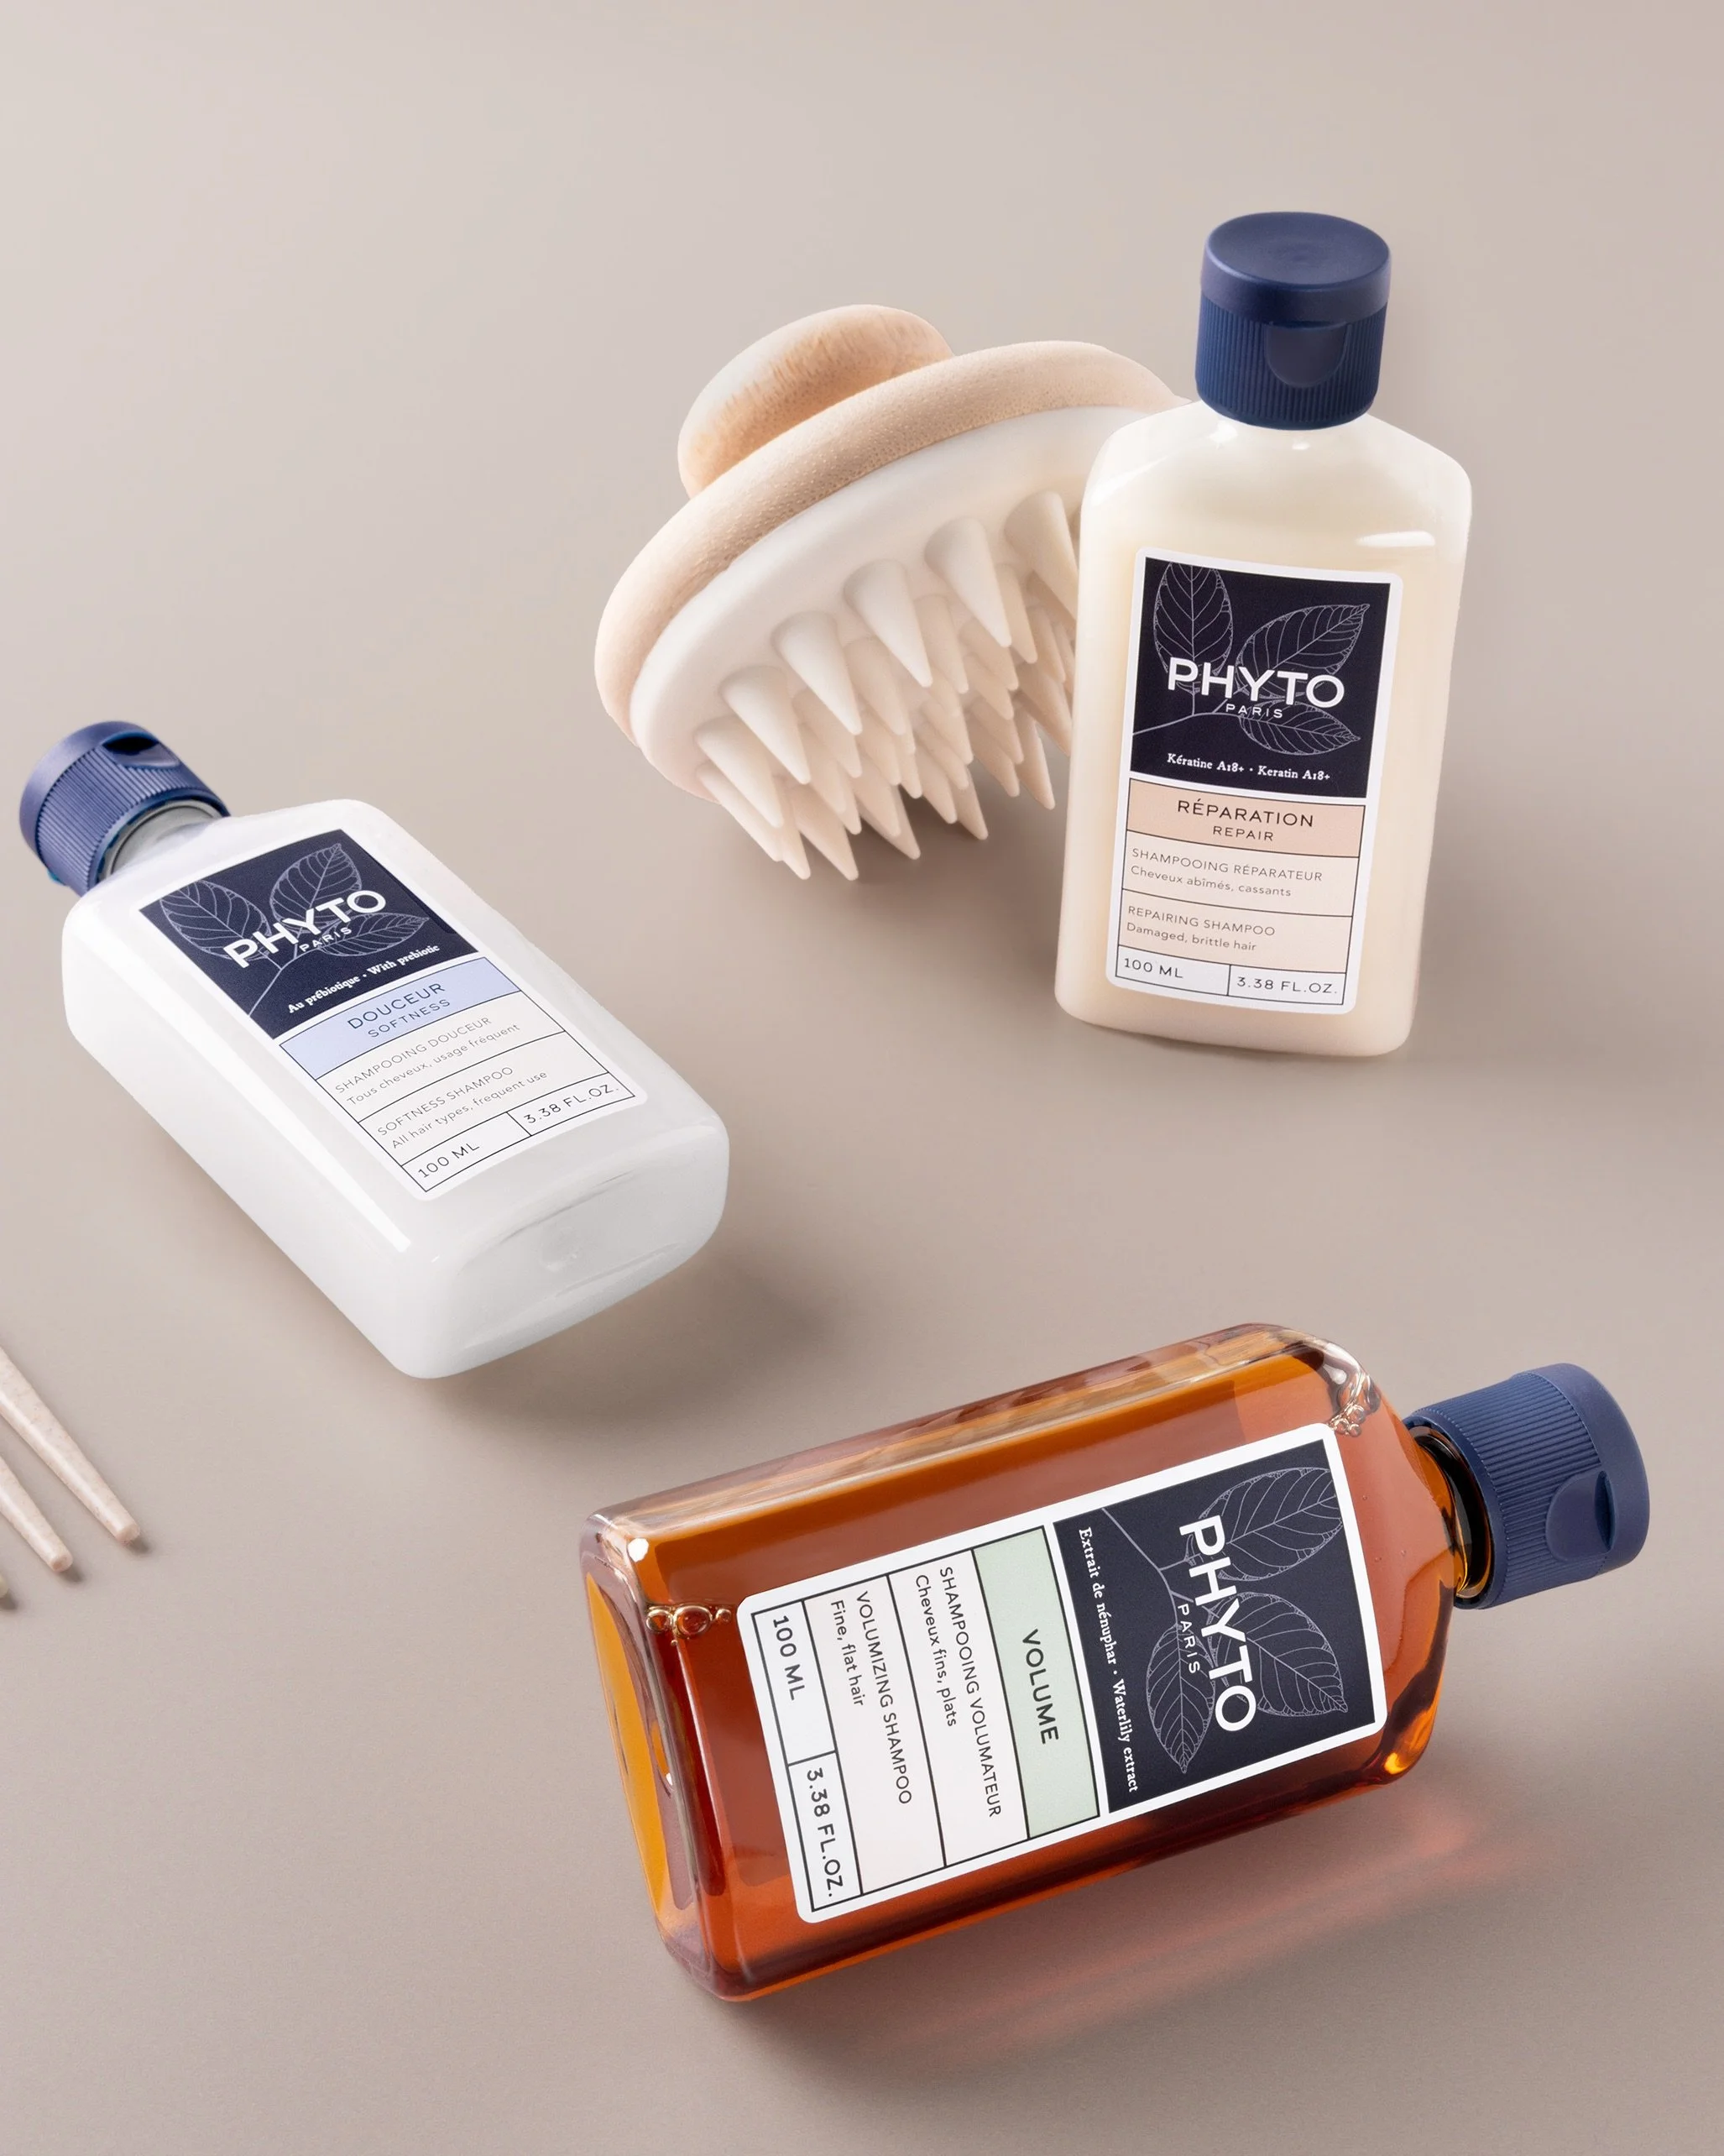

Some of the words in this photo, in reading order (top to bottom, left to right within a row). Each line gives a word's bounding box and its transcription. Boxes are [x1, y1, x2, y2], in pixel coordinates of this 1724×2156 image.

[1168, 657, 1345, 708] PHYTO
[1225, 704, 1283, 719] PARIS
[1167, 753, 1213, 769] Kératine
[1217, 761, 1244, 772] A18+
[1257, 766, 1298, 779] Keratin
[1303, 770, 1330, 781] A18+
[1178, 798, 1314, 827] RÉPARATION
[1213, 826, 1274, 841] REPAIR
[1131, 866, 1183, 883] Cheveux
[1238, 885, 1291, 897] cassants
[1132, 848, 1229, 873] SHAMPOOING
[1234, 864, 1322, 882] RÉPARATEUR
[223, 890, 386, 969] PHYTO
[299, 926, 352, 952] PARIS
[1126, 923, 1188, 944] Damaged,
[1192, 934, 1230, 949] brittle
[1234, 940, 1256, 951] hair
[1128, 906, 1199, 927] REPAIRING
[1204, 919, 1275, 936] SHAMPOO
[288, 1001, 306, 1013] Au
[305, 975, 360, 1007] prébiotique
[367, 960, 397, 976] With
[396, 944, 440, 966] prebiotic
[1124, 958, 1153, 973] 100
[1159, 965, 1183, 978] ML
[1237, 976, 1274, 990] 3.38
[1281, 981, 1337, 994] FL.OZ.
[347, 983, 446, 1030] DOUCEUR
[368, 999, 451, 1039] SOFTNESS
[335, 1044, 427, 1094] SHAMPOOING
[427, 1017, 492, 1049] DOUCEUR
[347, 1086, 378, 1106] Tous
[379, 1061, 433, 1090] cheveux,
[433, 1044, 468, 1067] usage
[468, 1024, 520, 1050] fréquent
[377, 1096, 447, 1136] SOFTNESS
[446, 1066, 514, 1102] SHAMPOO
[391, 1133, 409, 1149] All
[407, 1121, 434, 1138] hair
[435, 1105, 473, 1126] types,
[473, 1081, 525, 1107] frequent
[525, 1070, 548, 1086] use
[524, 1102, 562, 1124] 3.38
[563, 1084, 619, 1108] FL.OZ.
[417, 1156, 450, 1179] 100
[452, 1142, 480, 1160] ML
[1079, 1528, 1100, 1578] Extrait
[915, 1575, 940, 1647] Cheveux
[1092, 1582, 1105, 1600] de
[1097, 1604, 1118, 1666] nénuphar
[1177, 1604, 1200, 1674] PARIS
[1179, 1515, 1257, 1732] PHYTO
[773, 1615, 797, 1657] 100
[785, 1664, 806, 1701] ML
[830, 1600, 848, 1641] Fine,
[841, 1644, 856, 1672] flat
[849, 1677, 864, 1706] hair
[932, 1649, 948, 1683] fins,
[856, 1591, 894, 1708] VOLUMIZING
[883, 1713, 912, 1805] SHAMPOO
[937, 1688, 957, 1727] plats
[940, 1567, 980, 1694] SHAMPOOING
[967, 1698, 1001, 1818] VOLUMATEUR
[1021, 1629, 1059, 1745] VOLUME
[1112, 1678, 1132, 1745] Waterlily
[807, 1768, 831, 1817] 3.38
[1123, 1746, 1138, 1792] extract
[818, 1824, 844, 1897] FL.OZ.
